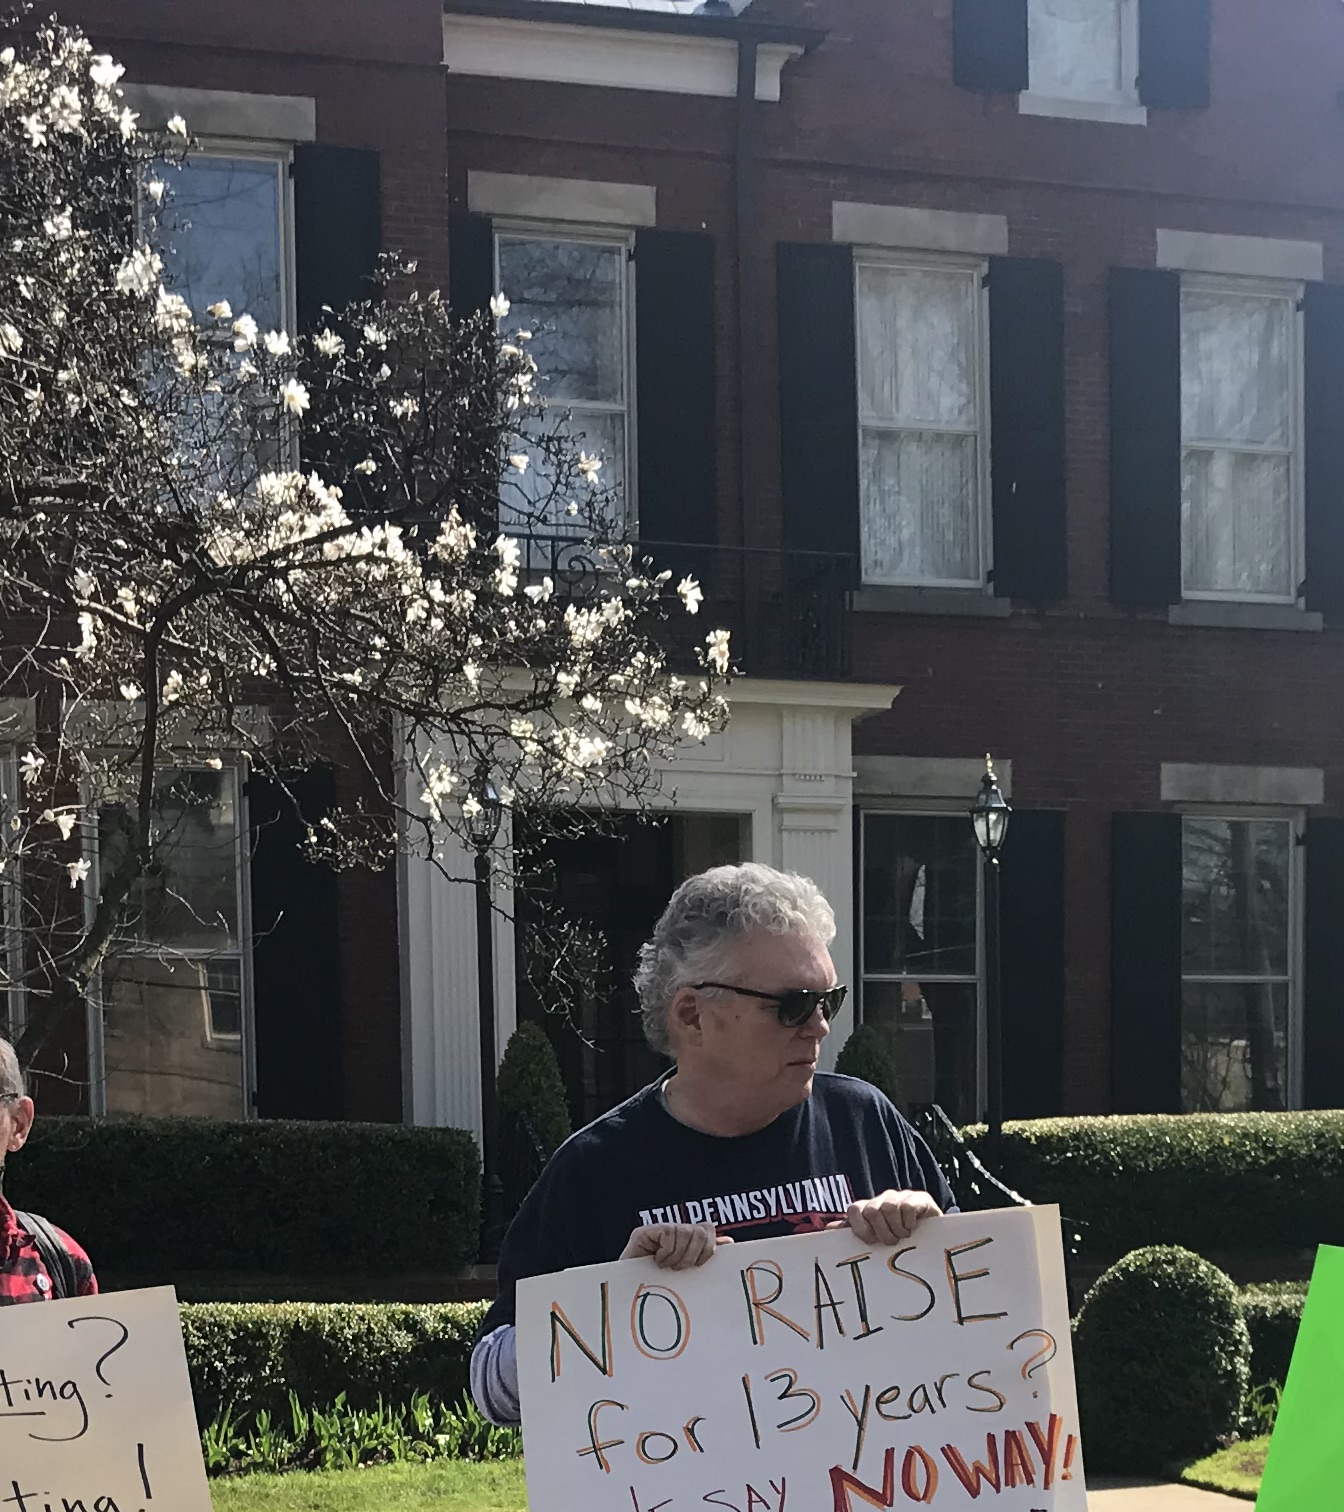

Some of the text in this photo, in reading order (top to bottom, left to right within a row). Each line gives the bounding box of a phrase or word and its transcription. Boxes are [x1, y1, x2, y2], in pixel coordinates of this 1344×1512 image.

[685, 1174, 852, 1227] PENNSYLVANIA
[550, 1236, 1010, 1384] NO RAISE
[576, 1327, 1058, 1474] for 13 years?
[940, 1412, 1078, 1499] WAY!
